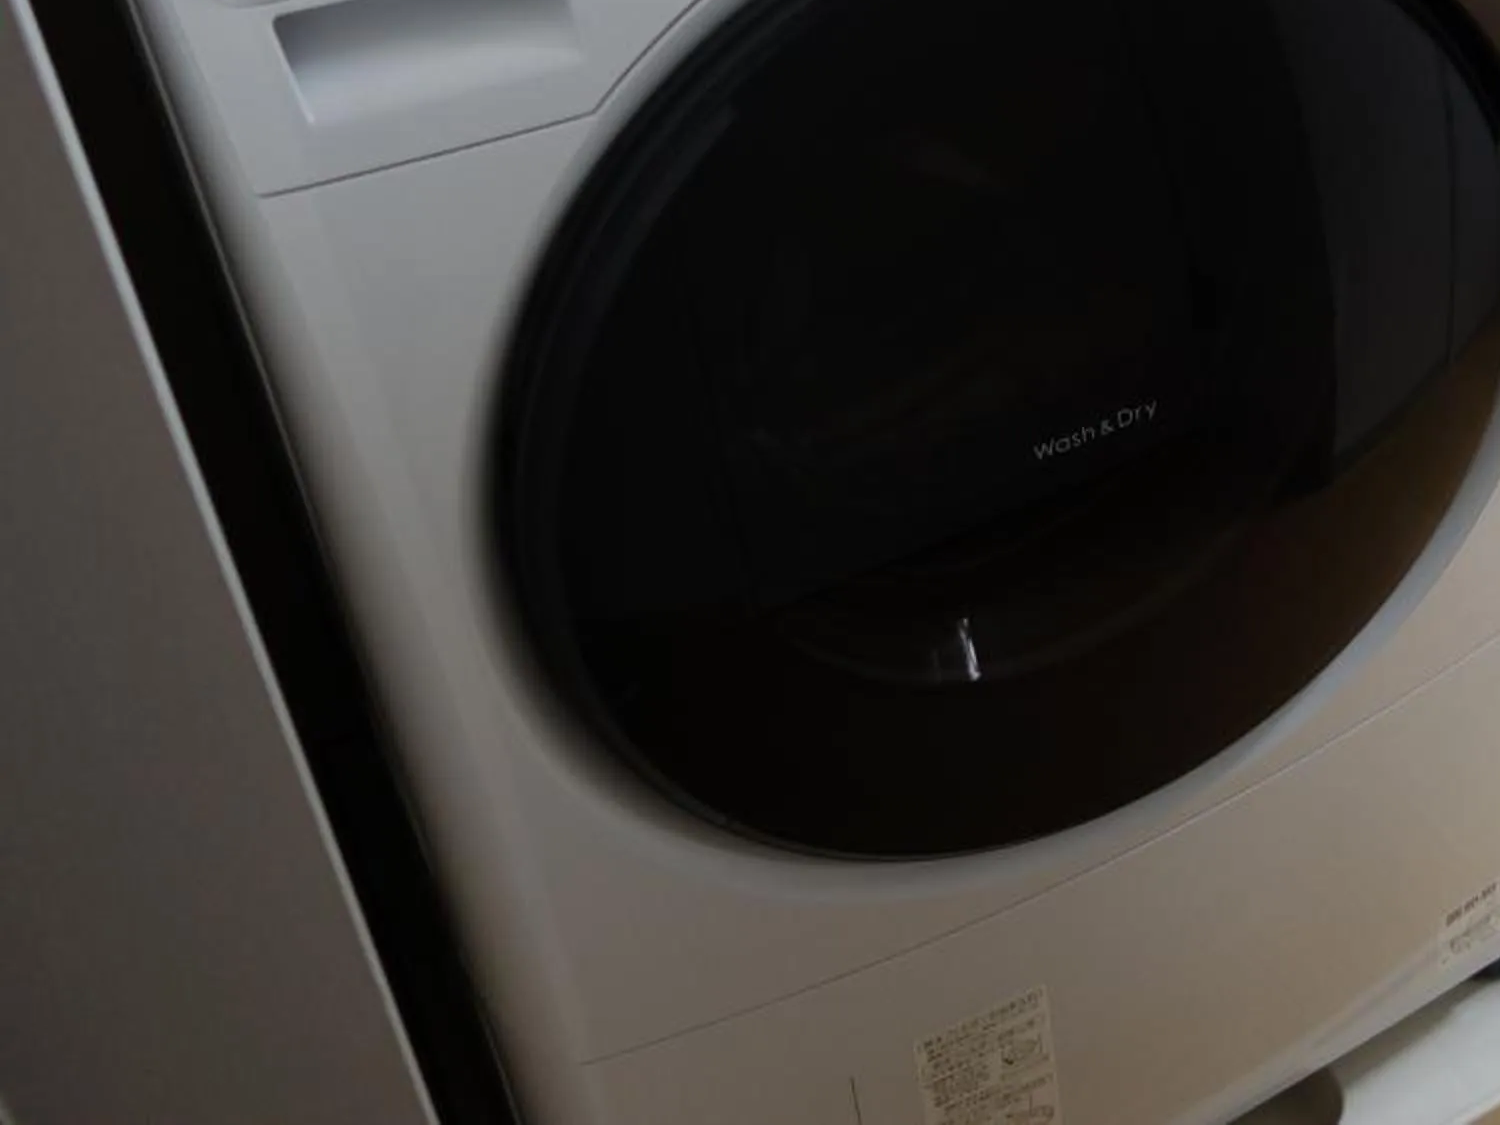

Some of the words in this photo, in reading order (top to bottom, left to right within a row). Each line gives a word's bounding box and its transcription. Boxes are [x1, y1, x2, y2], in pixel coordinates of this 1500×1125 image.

[1033, 426, 1095, 460] Wash
[1101, 419, 1115, 436] &
[1118, 400, 1157, 428] Dry
